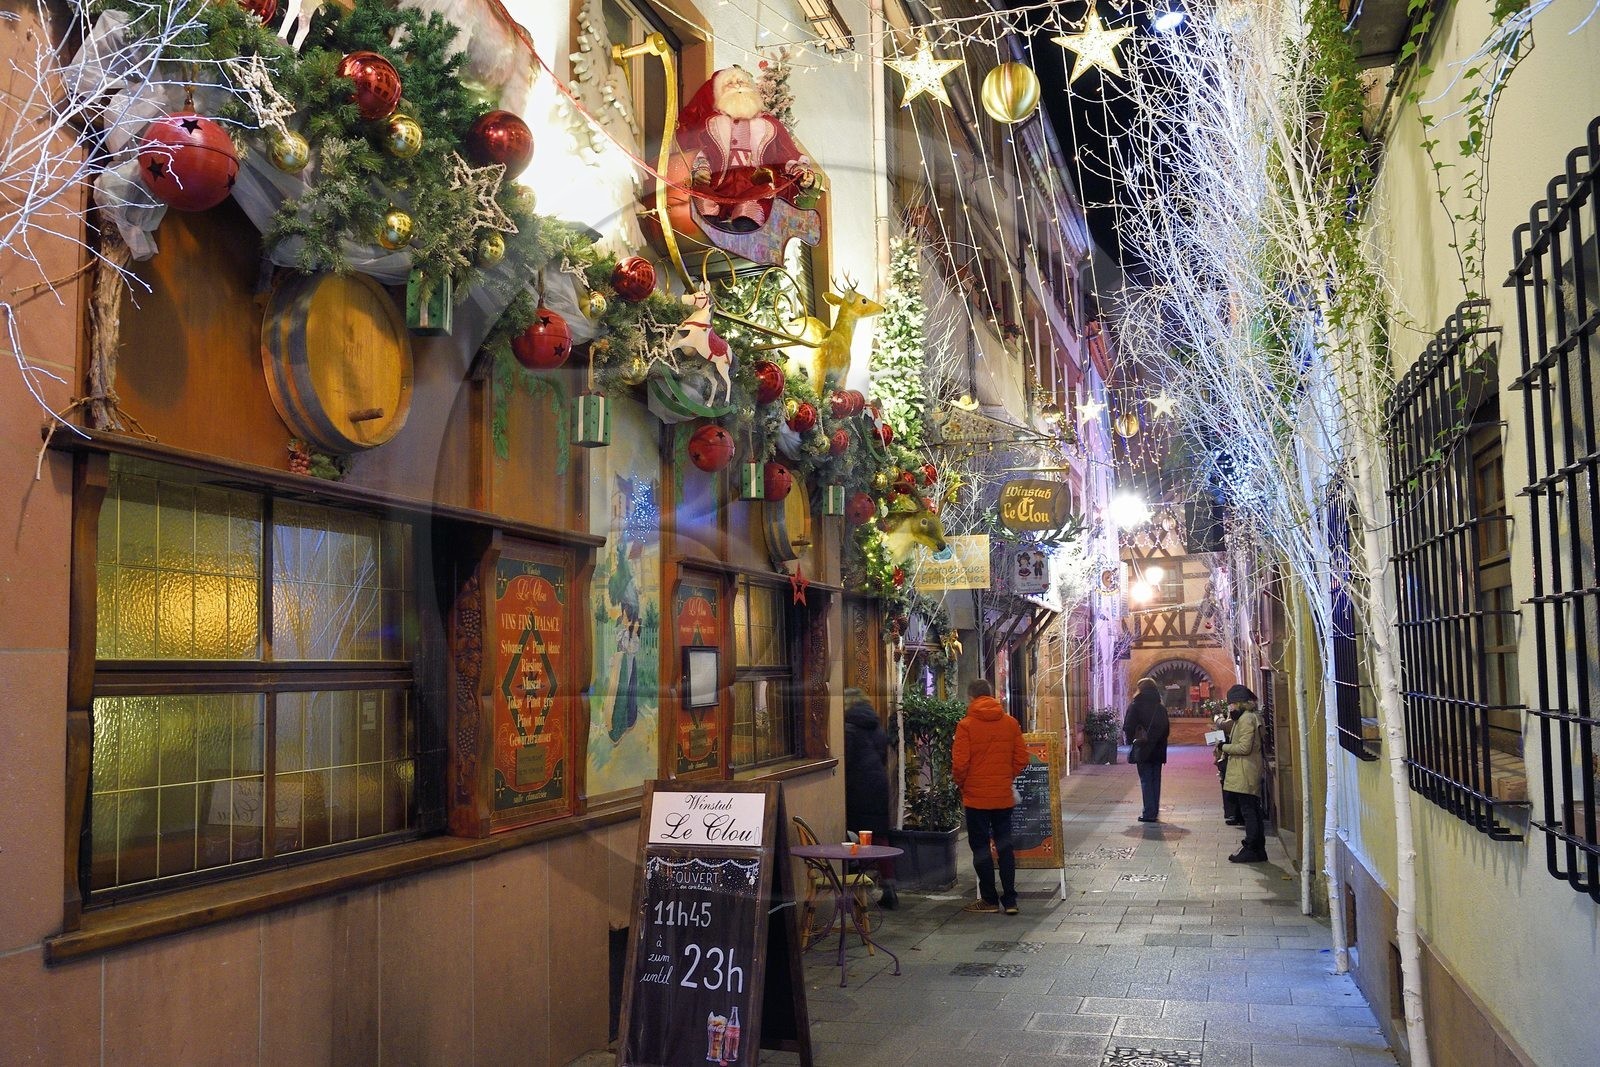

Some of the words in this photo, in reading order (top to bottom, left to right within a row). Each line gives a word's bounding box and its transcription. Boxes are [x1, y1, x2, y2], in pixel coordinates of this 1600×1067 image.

[1005, 486, 1052, 500] Winstub
[1017, 497, 1050, 523] Clou
[501, 613, 517, 630] VINS
[518, 614, 533, 631] FINS
[534, 615, 560, 632] D'ALSACE
[521, 658, 542, 673] Riesling
[517, 713, 532, 728] Pinot
[685, 794, 733, 810] Winstub
[660, 812, 692, 839] Le
[702, 812, 752, 843] Clou
[675, 871, 720, 884] OUVERT
[653, 900, 712, 928] 11h45
[656, 934, 663, 948] à
[639, 965, 674, 985] until
[648, 953, 670, 963] zum
[680, 943, 743, 994] 23h
